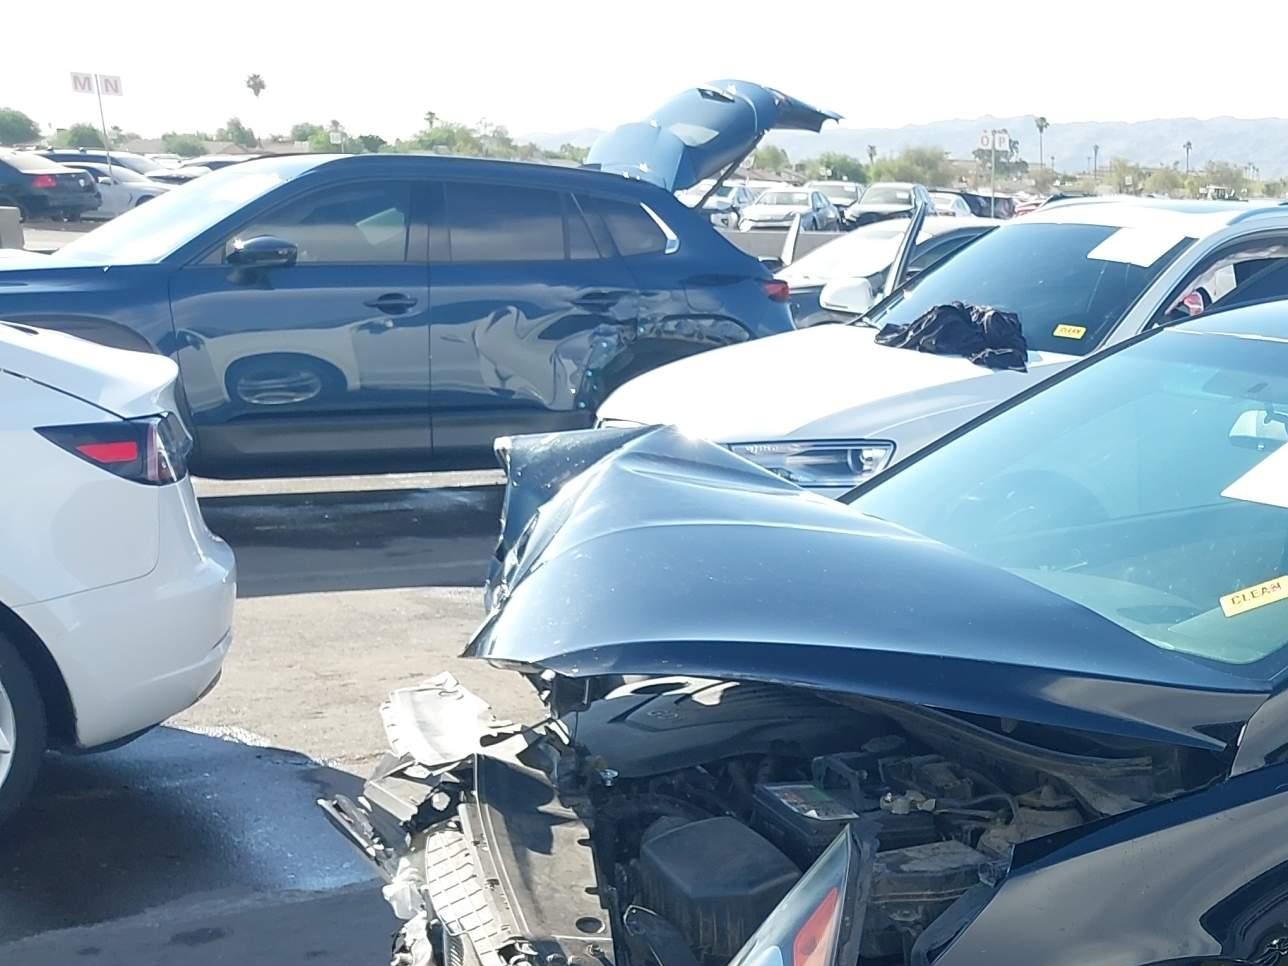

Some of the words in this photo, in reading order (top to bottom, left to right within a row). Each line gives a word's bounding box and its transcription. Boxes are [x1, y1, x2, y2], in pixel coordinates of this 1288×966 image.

[72, 75, 92, 91] M
[103, 78, 119, 93] N
[1230, 582, 1282, 606] CLEAN
